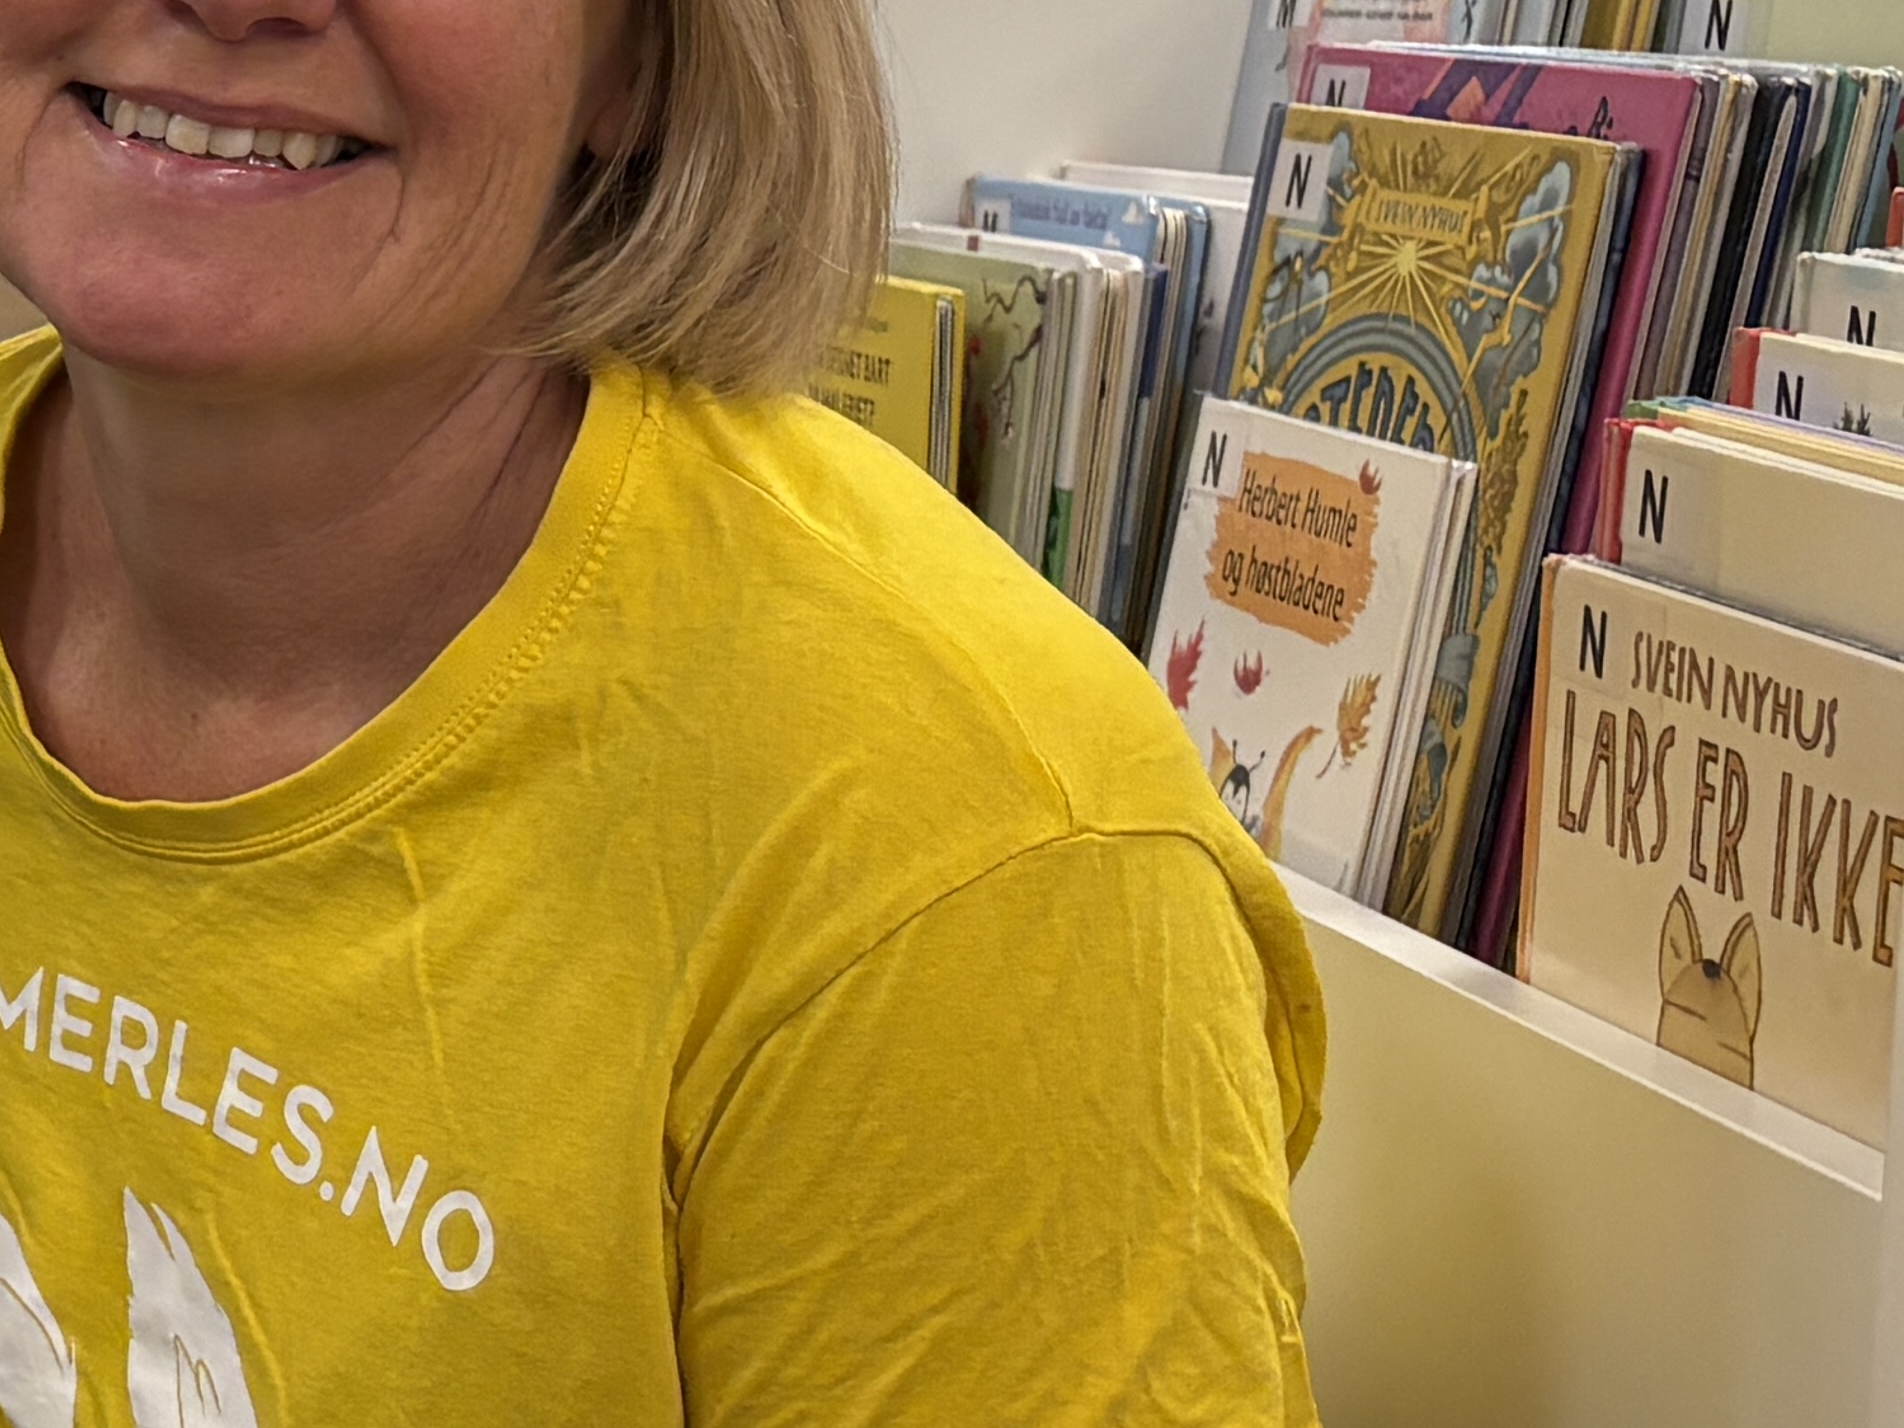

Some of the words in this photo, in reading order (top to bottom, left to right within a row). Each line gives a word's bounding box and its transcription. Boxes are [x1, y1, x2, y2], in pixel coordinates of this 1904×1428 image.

[1285, 153, 1313, 210] N
[1774, 370, 1804, 420] N
[1202, 430, 1228, 488] N
[1236, 469, 1300, 529] Herbert
[1301, 489, 1358, 549] Humle
[1637, 469, 1669, 543] N
[1222, 546, 1242, 597] og
[1245, 545, 1346, 623] høstbladene
[1578, 604, 1607, 679] N
[1631, 630, 1714, 711] SVEIN
[1720, 665, 1839, 758] NYHUS
[1557, 688, 1677, 866] LARS
[1690, 736, 1750, 903] ER
[1769, 771, 1904, 969] IKKE
